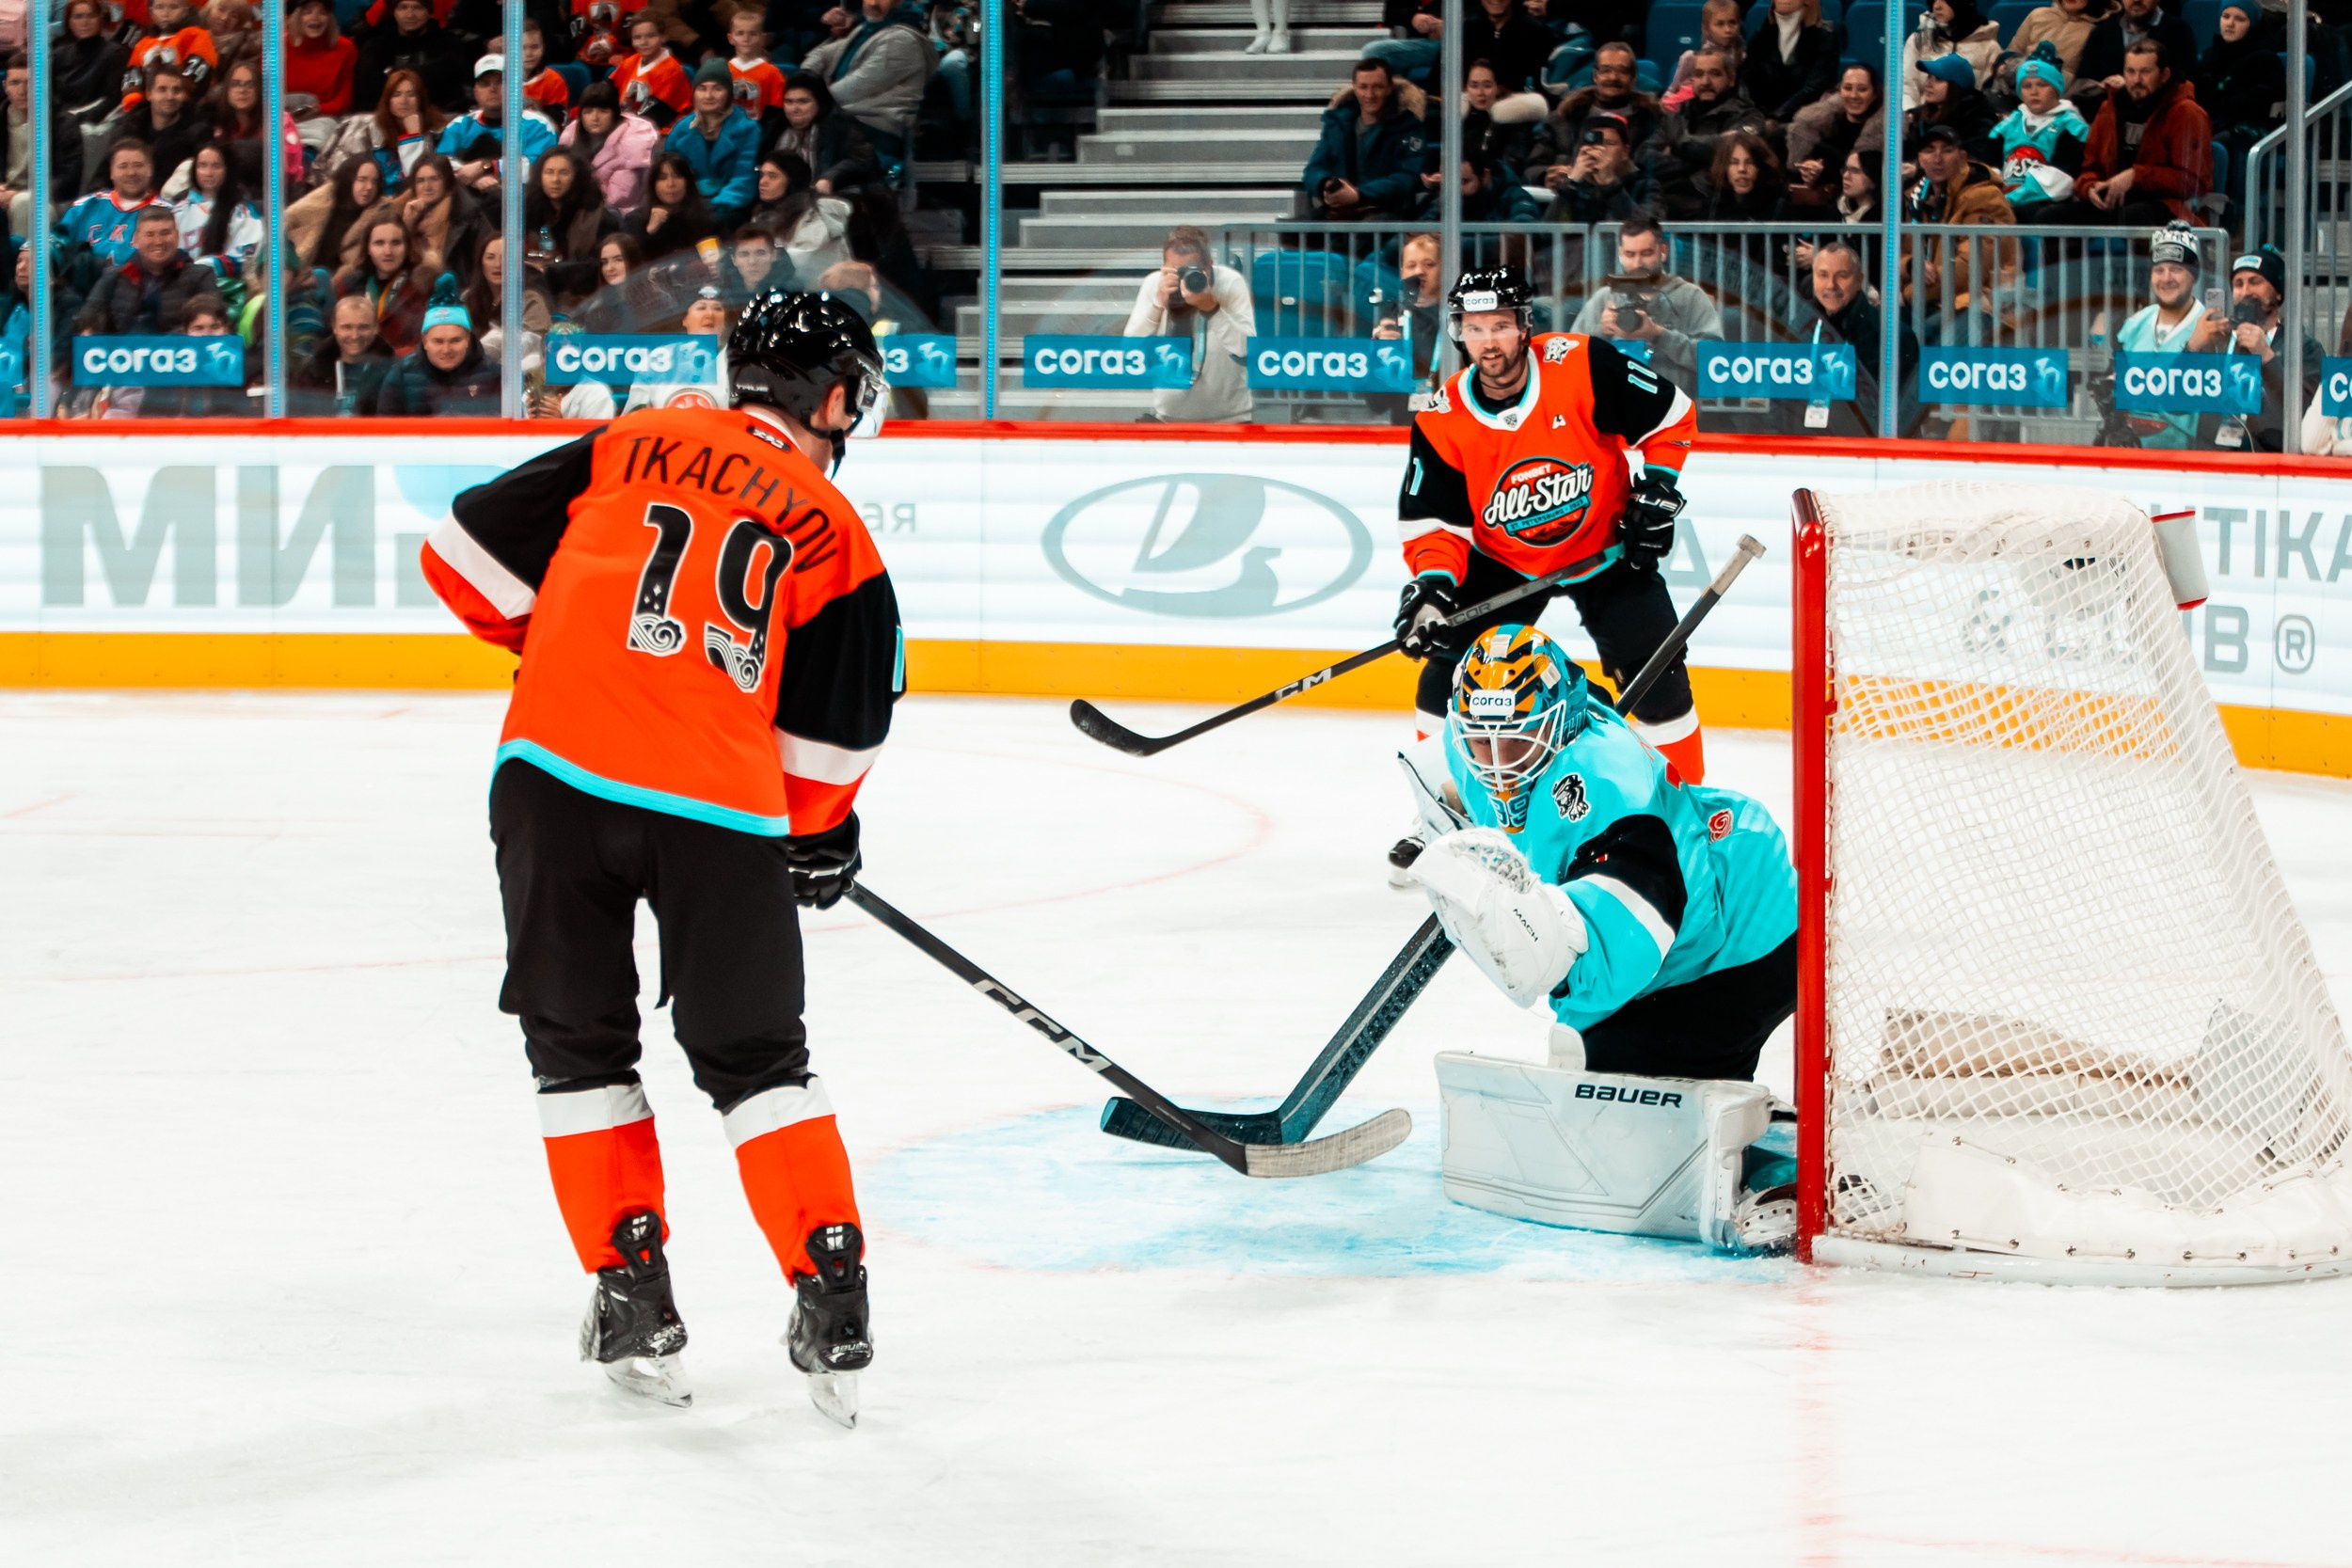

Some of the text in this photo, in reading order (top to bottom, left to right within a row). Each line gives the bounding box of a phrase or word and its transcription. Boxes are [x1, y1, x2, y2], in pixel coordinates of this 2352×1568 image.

[623, 436, 837, 574] TKACHYOV
[1484, 468, 1593, 525] All-Star
[1511, 464, 1551, 483] FONBET
[627, 501, 794, 693] 19
[1471, 695, 1513, 707] согаз
[973, 979, 1112, 1072] CCM
